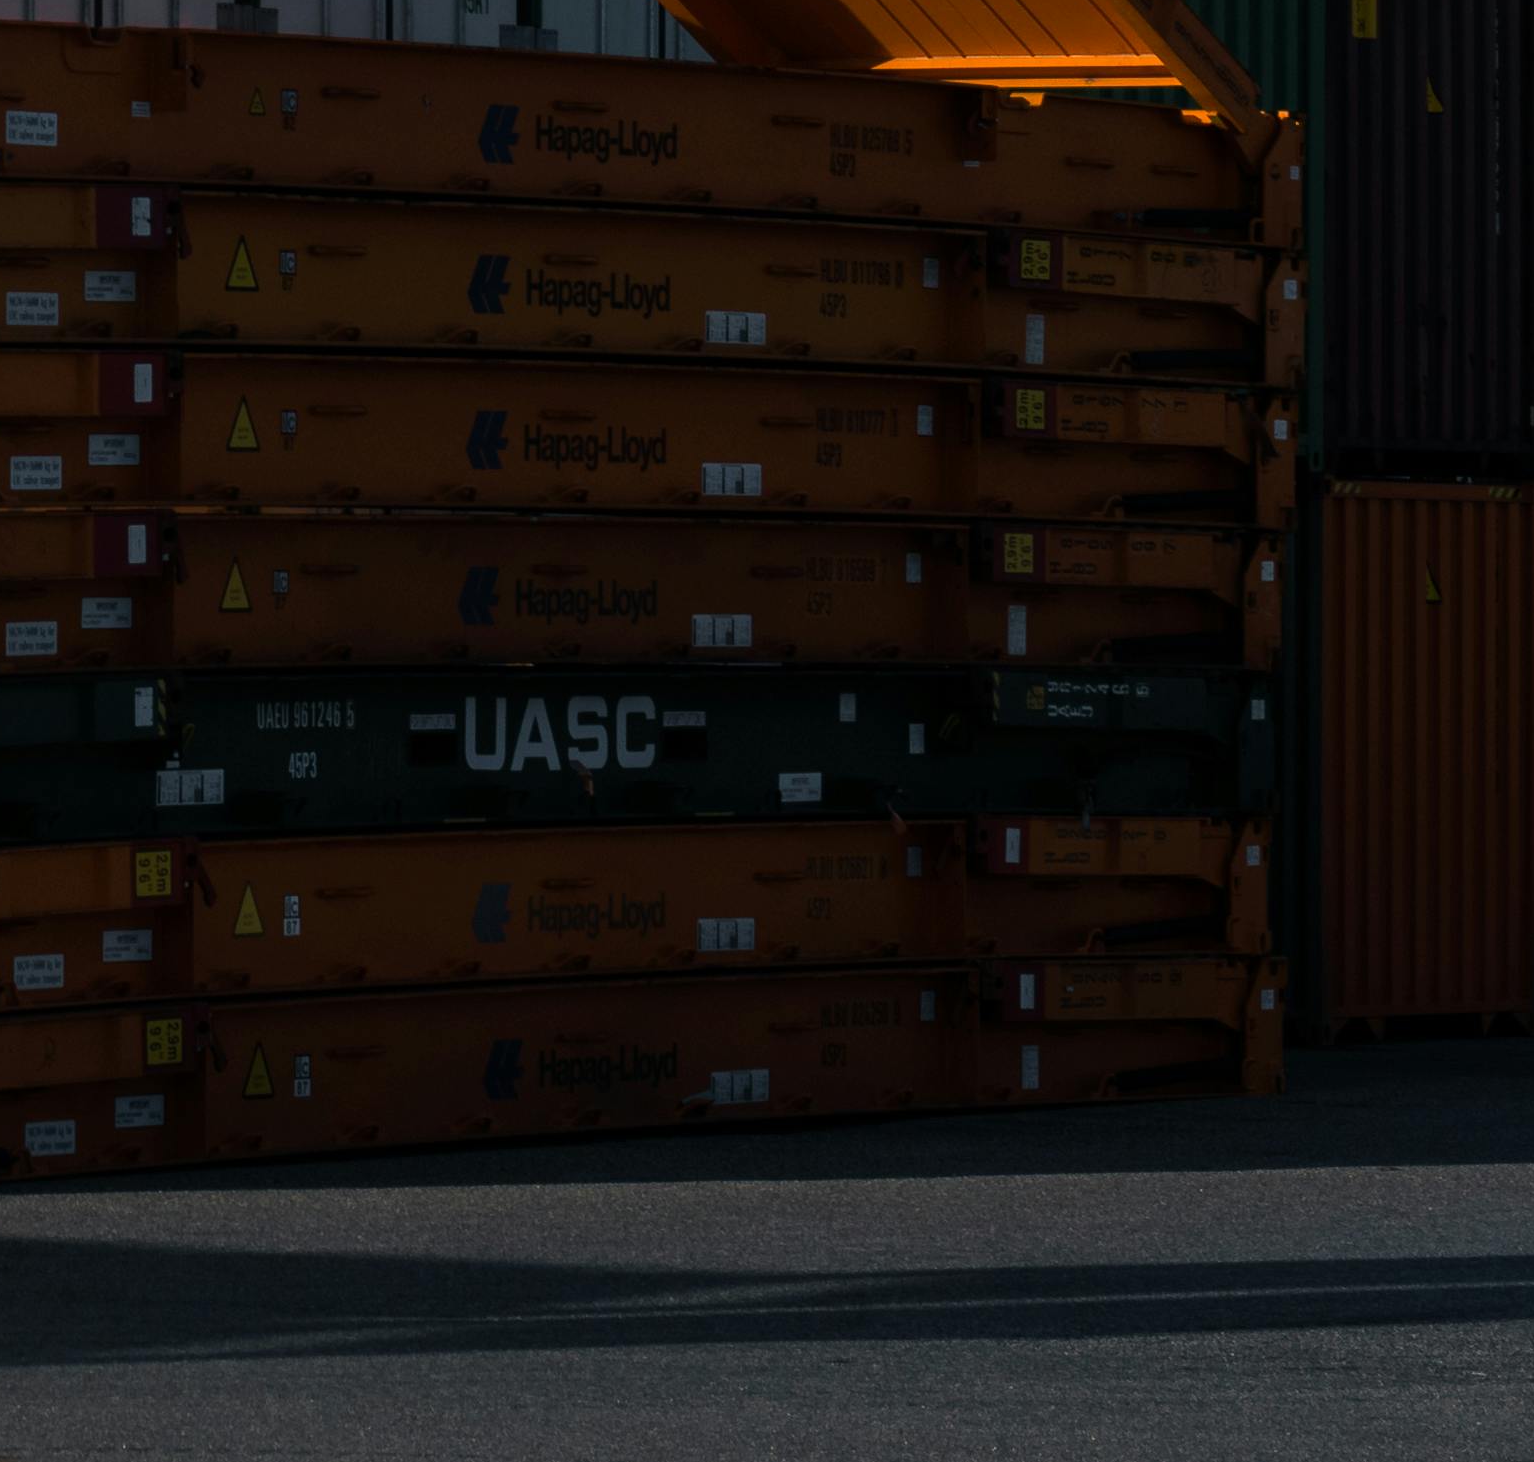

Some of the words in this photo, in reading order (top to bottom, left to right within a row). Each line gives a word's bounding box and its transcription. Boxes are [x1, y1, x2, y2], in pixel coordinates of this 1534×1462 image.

[536, 115, 677, 165] Hapag-Lloyd
[526, 269, 670, 318] Hapag-Lloyd
[524, 424, 666, 470] Hapag-Lloyd
[516, 580, 657, 624] Hapag-Lloyd
[257, 700, 289, 729] UAEU
[294, 700, 341, 728] 961246
[346, 701, 354, 729] 5
[464, 695, 657, 772] UASC
[289, 750, 317, 779] 45P3
[528, 892, 666, 938] Hapag-Lloyd
[538, 1043, 677, 1089] Hapag-Lloyd
